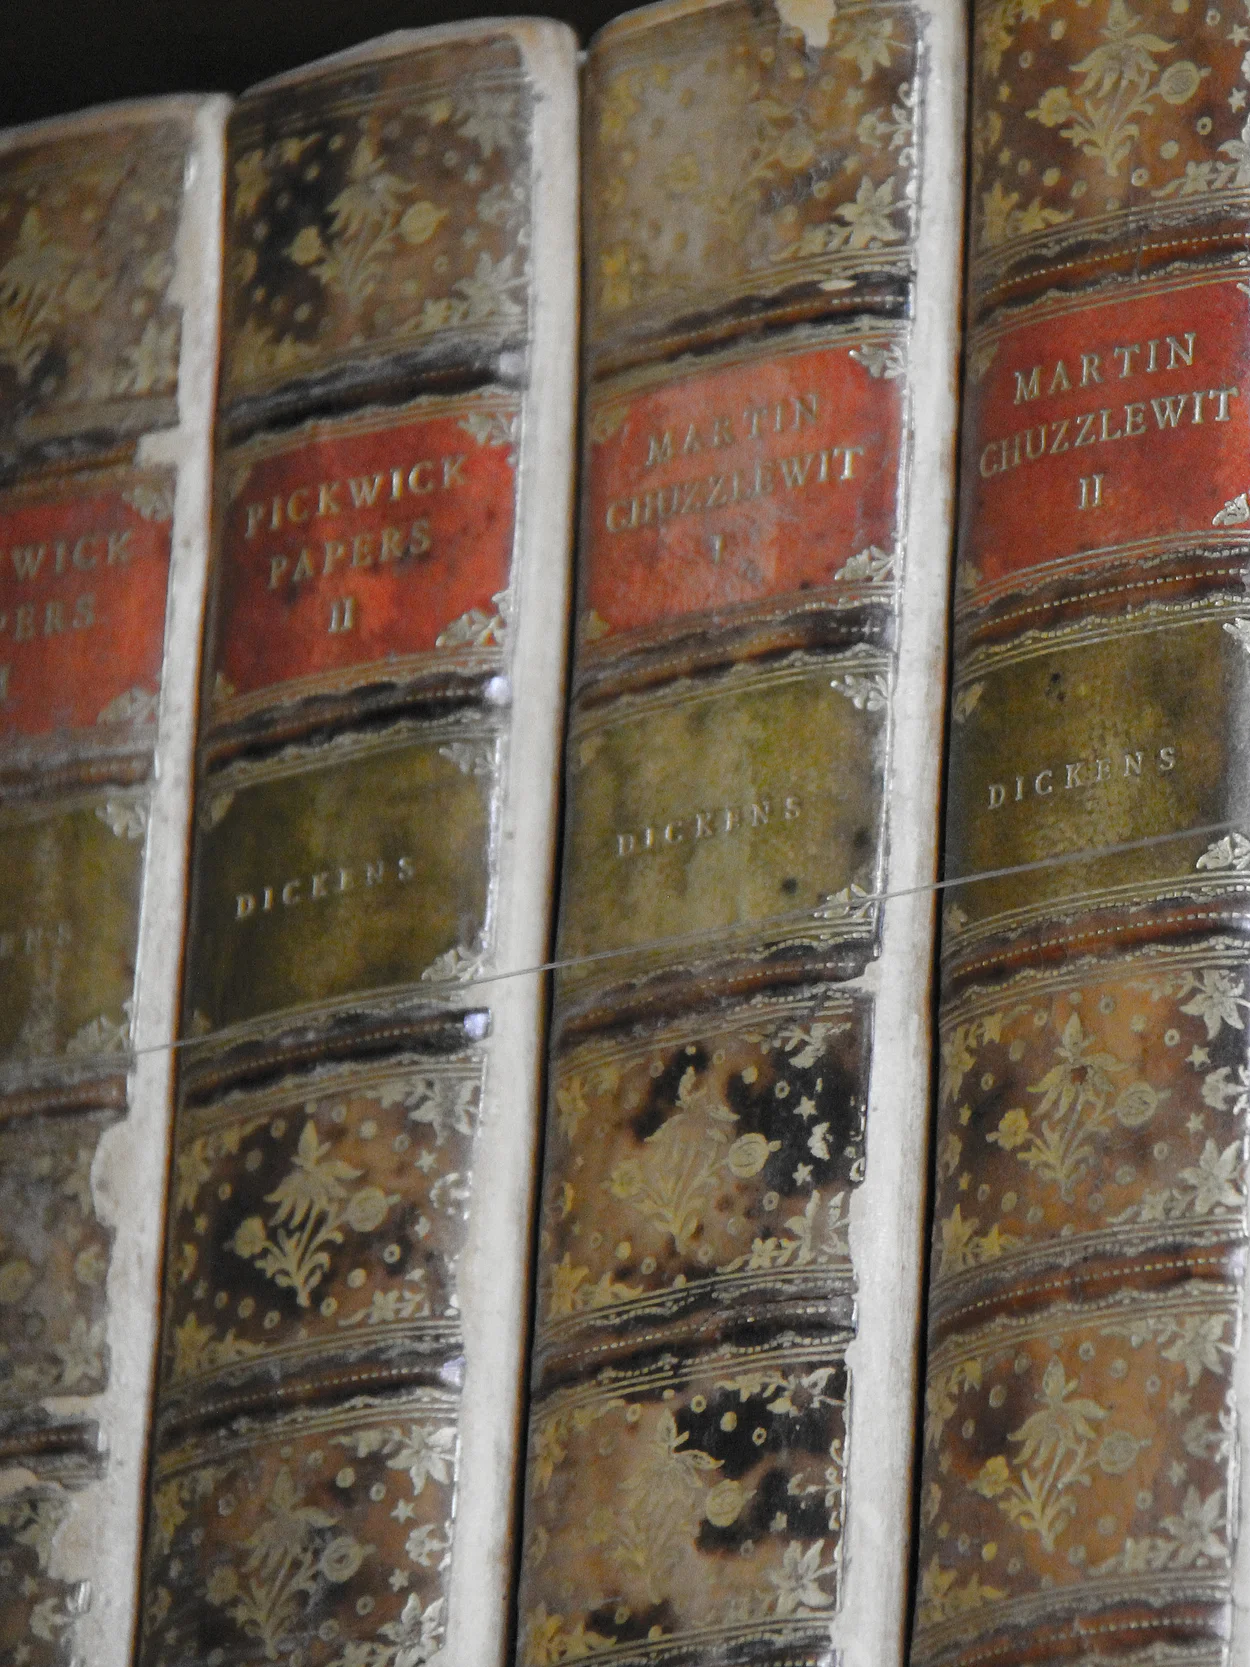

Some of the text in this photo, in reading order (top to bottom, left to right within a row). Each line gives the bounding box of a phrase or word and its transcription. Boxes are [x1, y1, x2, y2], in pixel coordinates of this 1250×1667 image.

[1013, 332, 1197, 405] MARTIN
[645, 393, 819, 467] MARTIN
[979, 386, 1238, 480] CHUZZLEWIT
[244, 453, 468, 538] PICKWICK
[605, 445, 865, 533] CHUZZLEWIT
[269, 521, 432, 590] PAPERS
[988, 746, 1177, 809] DICKENS
[616, 796, 802, 857] DICKENS
[235, 857, 415, 919] DICKENS
